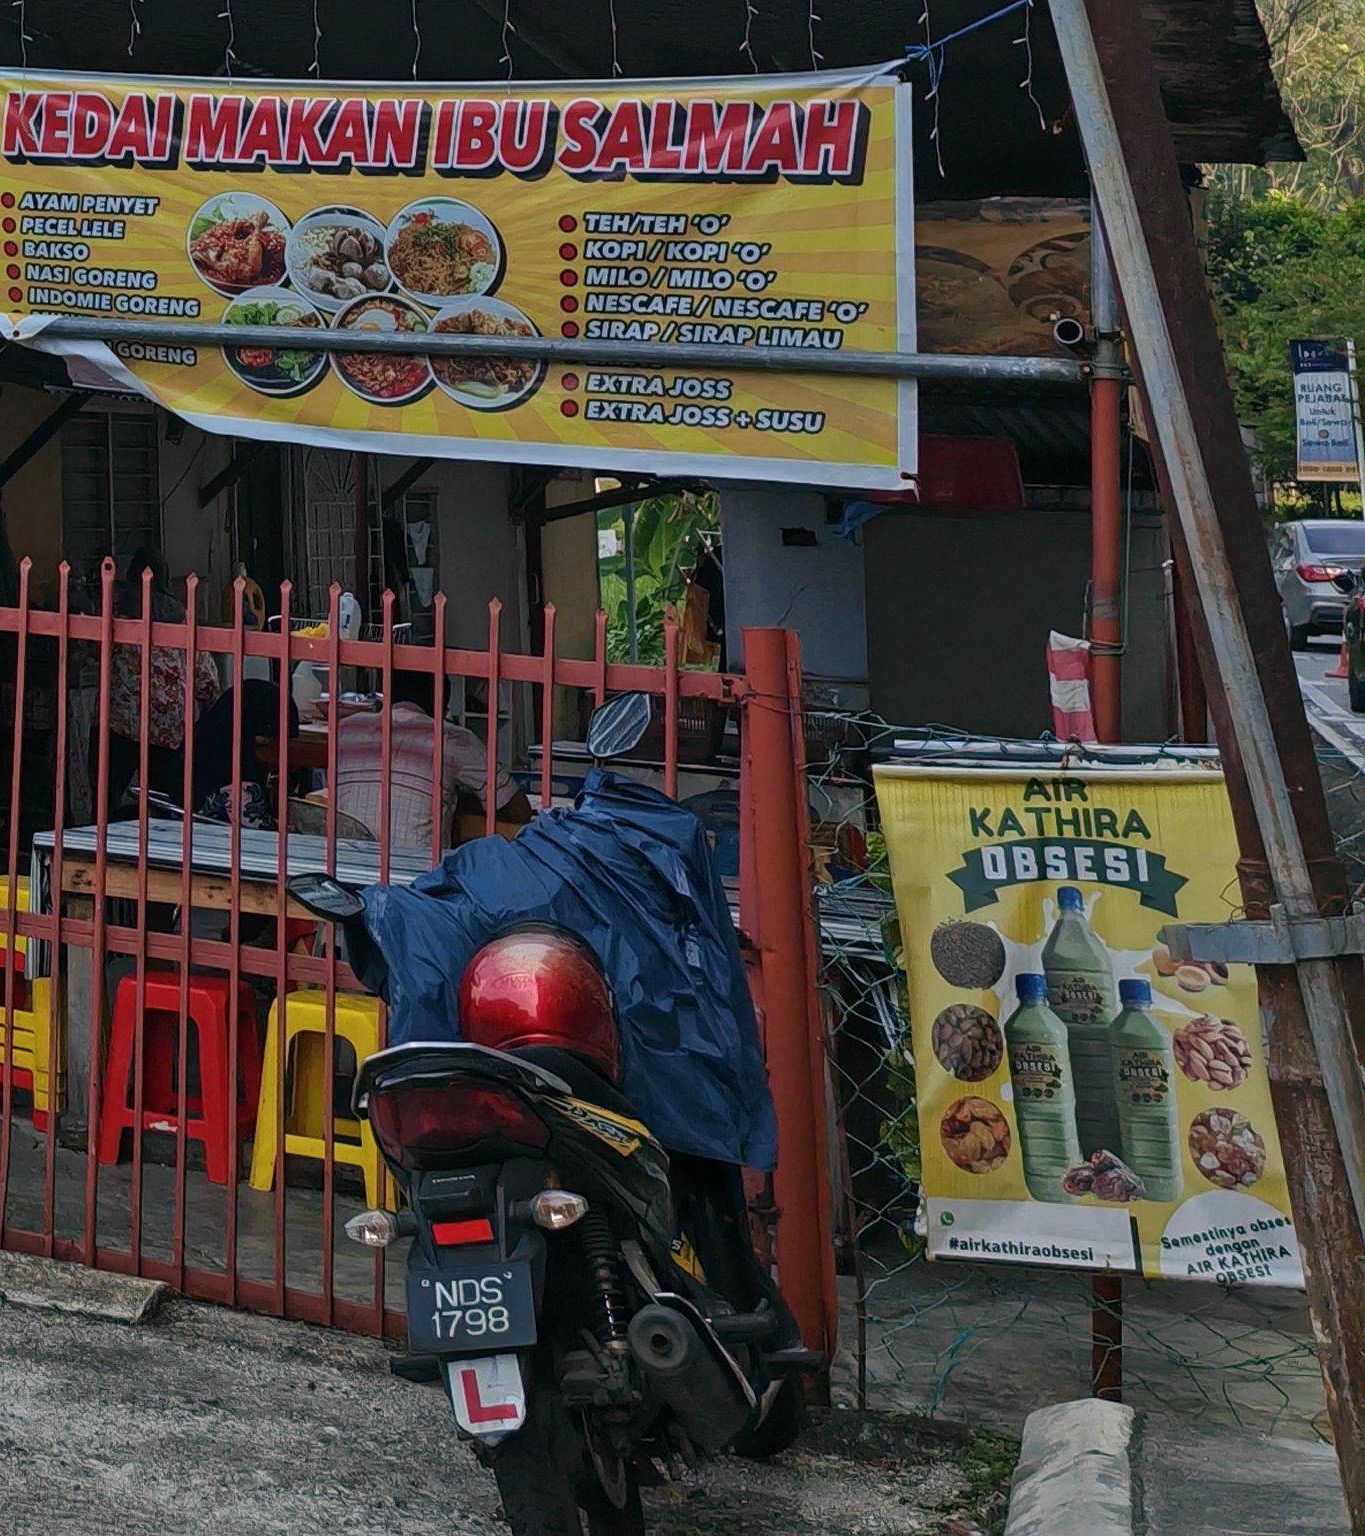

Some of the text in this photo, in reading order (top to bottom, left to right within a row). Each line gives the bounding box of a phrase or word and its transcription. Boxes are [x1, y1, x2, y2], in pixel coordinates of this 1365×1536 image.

[2, 91, 867, 181] KEDAI MAKAN IBU SALMAH
[19, 193, 159, 215] AYAM PENYET
[21, 217, 125, 239] PECEL LELE
[584, 213, 687, 234] TEH/TEH
[23, 241, 90, 261] BAKSO
[584, 241, 646, 260] KOPI
[648, 241, 663, 264] /
[665, 243, 728, 262] KOPI
[25, 264, 157, 290] NASI GORENG
[584, 267, 647, 287] MILO
[650, 267, 666, 289] /
[668, 269, 733, 290] MILO
[28, 287, 201, 317] INDOMIE GORENG
[584, 293, 694, 316] NESCAFE
[694, 296, 711, 317] /
[712, 298, 823, 321] NESCAFE
[585, 320, 843, 349] SIRAP / SIRAP LIMAU
[117, 340, 196, 365] GORENG
[585, 374, 733, 400] EXTRA JOSS
[1300, 383, 1342, 393] RUANG
[585, 400, 825, 433] EXTRA JOSS + SUSU
[1023, 777, 1089, 802] AIR
[969, 807, 1152, 839] KATHIRA
[981, 845, 1148, 882] OBSESI
[949, 1236, 1094, 1261] #airkathiraobsesi
[1161, 1225, 1246, 1249] Semestinya
[1206, 1239, 1260, 1257] dengan
[1187, 1245, 1291, 1275] AIR KATHIRA
[1216, 1264, 1272, 1284] OBSESI
[435, 1276, 503, 1309] NDS
[431, 1306, 509, 1338] 1798
[461, 1369, 519, 1424] L
